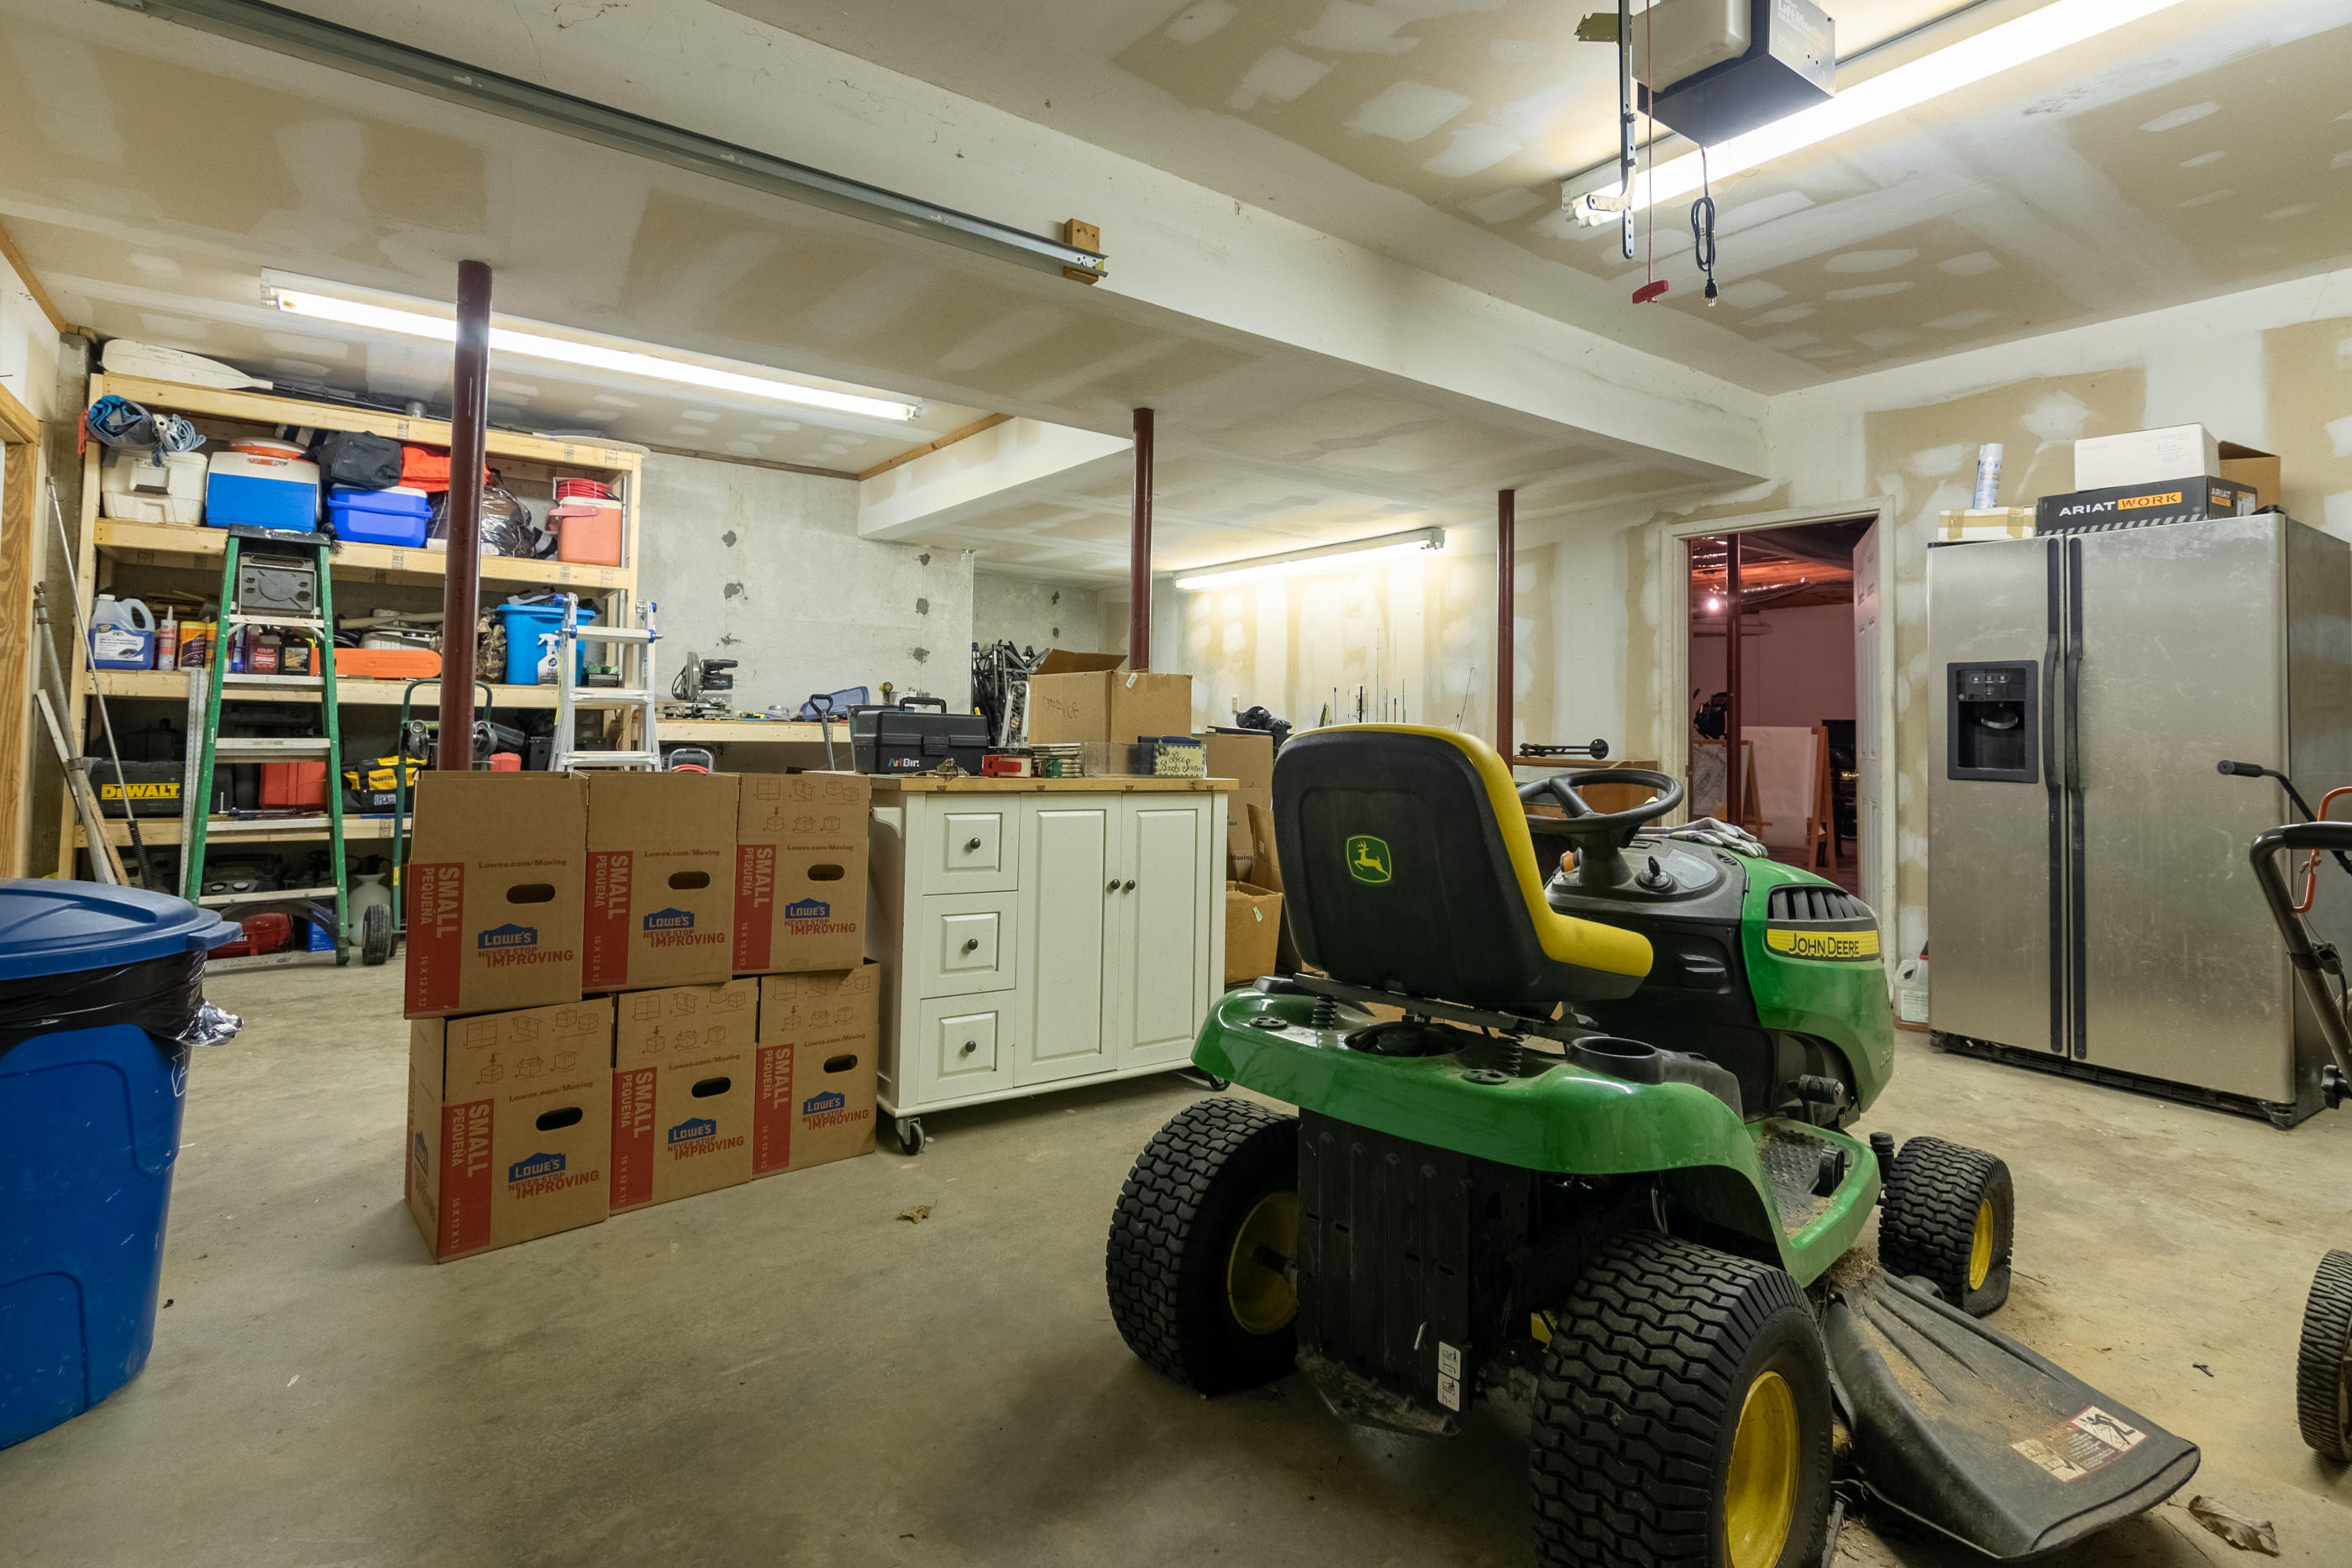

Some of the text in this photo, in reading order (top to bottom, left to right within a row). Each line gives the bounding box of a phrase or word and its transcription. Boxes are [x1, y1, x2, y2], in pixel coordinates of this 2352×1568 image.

[2211, 487, 2231, 499] ARIAT
[2059, 494, 2177, 517] ARIAT WORK
[887, 758, 920, 768] ArtBin
[644, 849, 721, 857] Lowes.com/Moving
[478, 859, 567, 868] Lowes.com/Moving
[743, 847, 754, 896] PEQUEÑA
[753, 847, 773, 908] SMALL
[594, 855, 607, 908] PEQUEÑA
[607, 855, 628, 920] SMALL
[421, 868, 436, 926] PEQUEÑA
[437, 867, 460, 939] SMALL
[790, 906, 826, 916] LOWE'S
[648, 915, 690, 928] LOWE'S
[740, 922, 748, 931] 16
[790, 923, 856, 936] IMPROVING
[485, 932, 532, 947] LOWE'S
[594, 936, 601, 945] 16
[650, 933, 725, 948] IMPROVING
[740, 939, 747, 948] 12
[1788, 933, 1860, 955] JOHN DEERE
[421, 956, 428, 965] 16
[487, 950, 574, 968] IMPROVING
[593, 954, 601, 963] 12
[739, 957, 746, 967] 12
[420, 977, 428, 986] 12
[592, 973, 600, 982] 12
[419, 998, 428, 1007] 12
[804, 1033, 866, 1047] Lowes.com/Moving
[669, 1054, 741, 1071] Lowes.com/Moving
[762, 1050, 774, 1099] PEQUEÑA
[773, 1047, 790, 1109] SMALL
[509, 1081, 593, 1102] Lowes.com/Moving
[621, 1074, 633, 1129] PEQUEÑA
[633, 1072, 654, 1139] SMALL
[807, 1097, 841, 1112] LOWE'S
[808, 1109, 869, 1130] IMPROVING
[673, 1124, 711, 1141] LOWE'S
[762, 1125, 769, 1134] 16
[451, 1108, 465, 1167] PEQUEÑA
[467, 1104, 491, 1177] SMALL
[675, 1135, 745, 1161] IMPROVING
[761, 1142, 768, 1151] 12
[515, 1158, 560, 1178] LOWE'S
[620, 1156, 627, 1166] 16
[760, 1160, 768, 1168] 12
[517, 1170, 599, 1200] IMPROVING
[619, 1175, 627, 1185] 12
[452, 1198, 460, 1207] 16
[618, 1194, 626, 1204] 12
[451, 1219, 459, 1229] 12
[450, 1240, 459, 1251] 12
